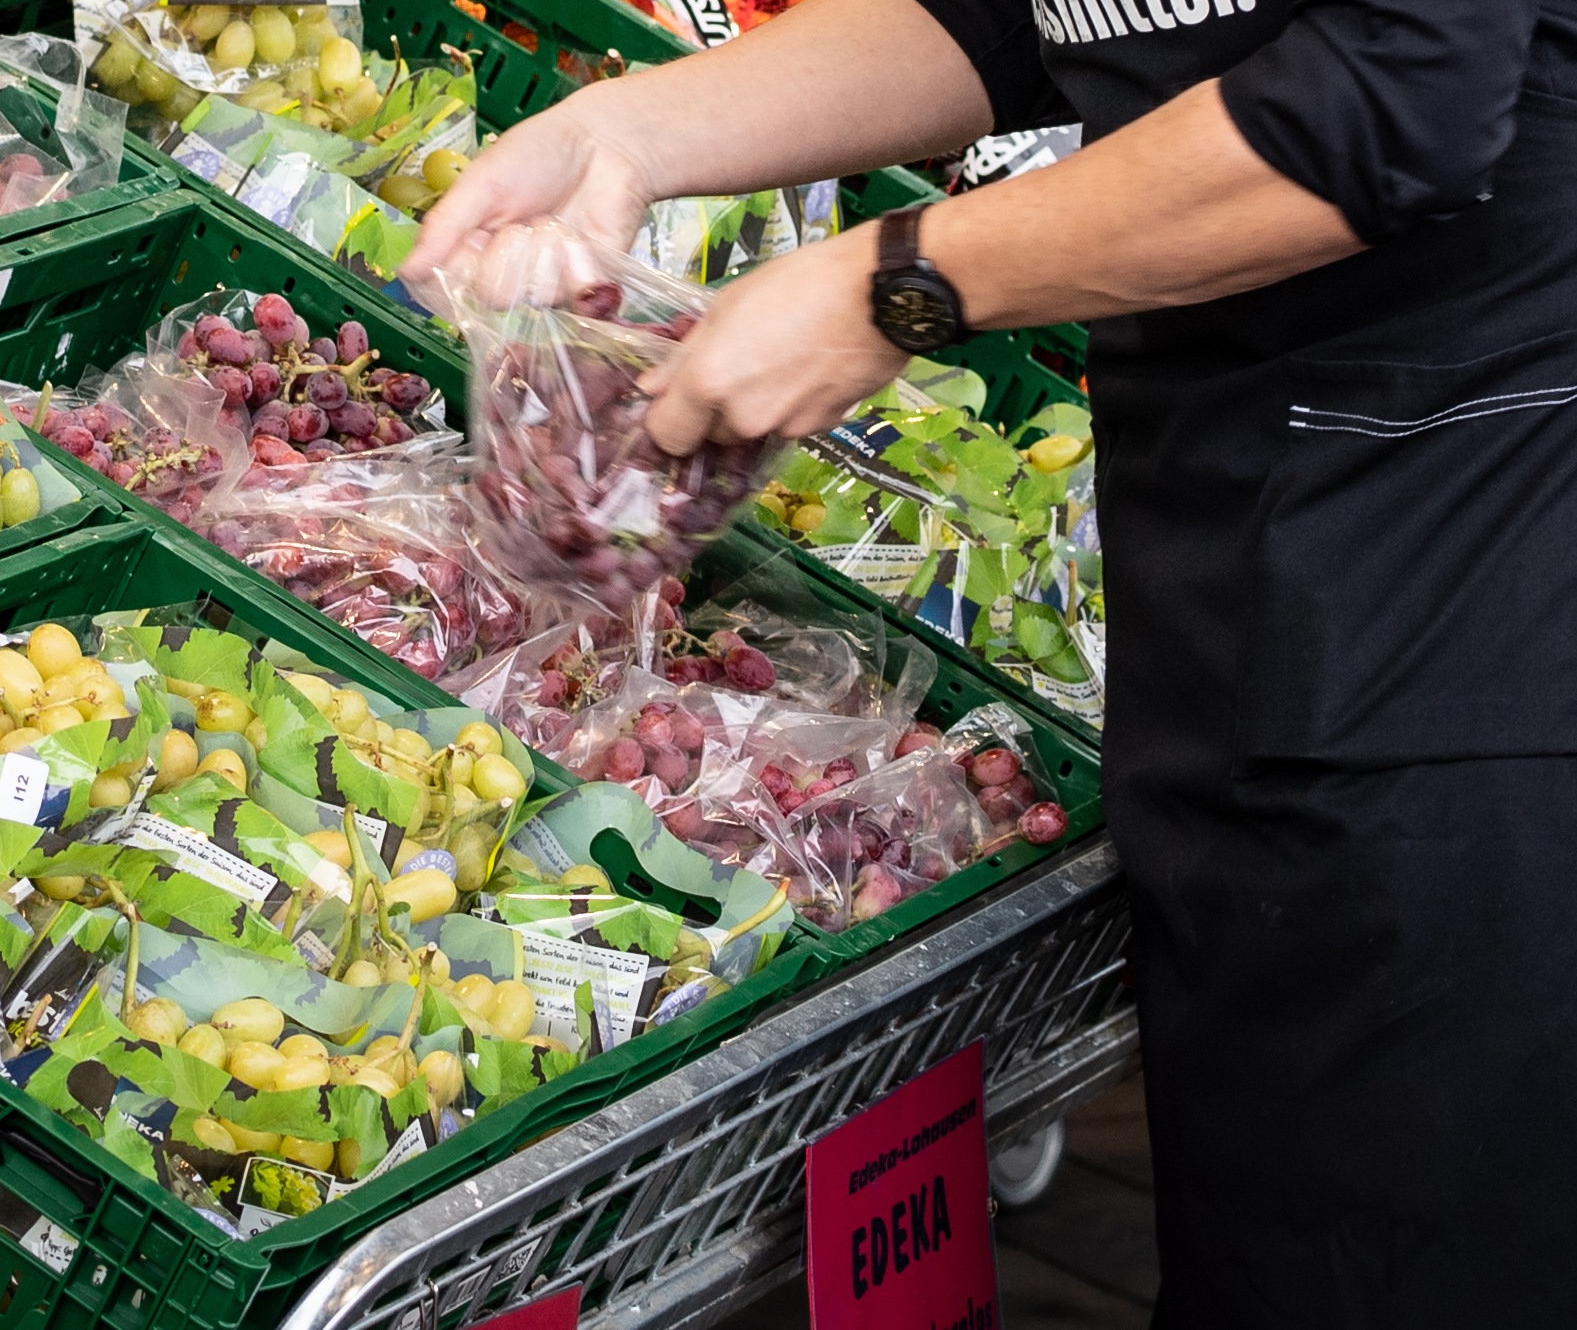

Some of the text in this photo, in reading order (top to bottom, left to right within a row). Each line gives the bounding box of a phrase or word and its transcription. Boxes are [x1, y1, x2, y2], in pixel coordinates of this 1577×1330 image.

[832, 427, 877, 460] EDEKA
[410, 854, 428, 871] DIE
[542, 948, 641, 976] Sorten der das sind
[555, 976, 571, 988] Feld
[614, 989, 630, 1000] und
[848, 1098, 978, 1197] Edeka-Lohausen
[851, 1175, 953, 1301] EDEKA
